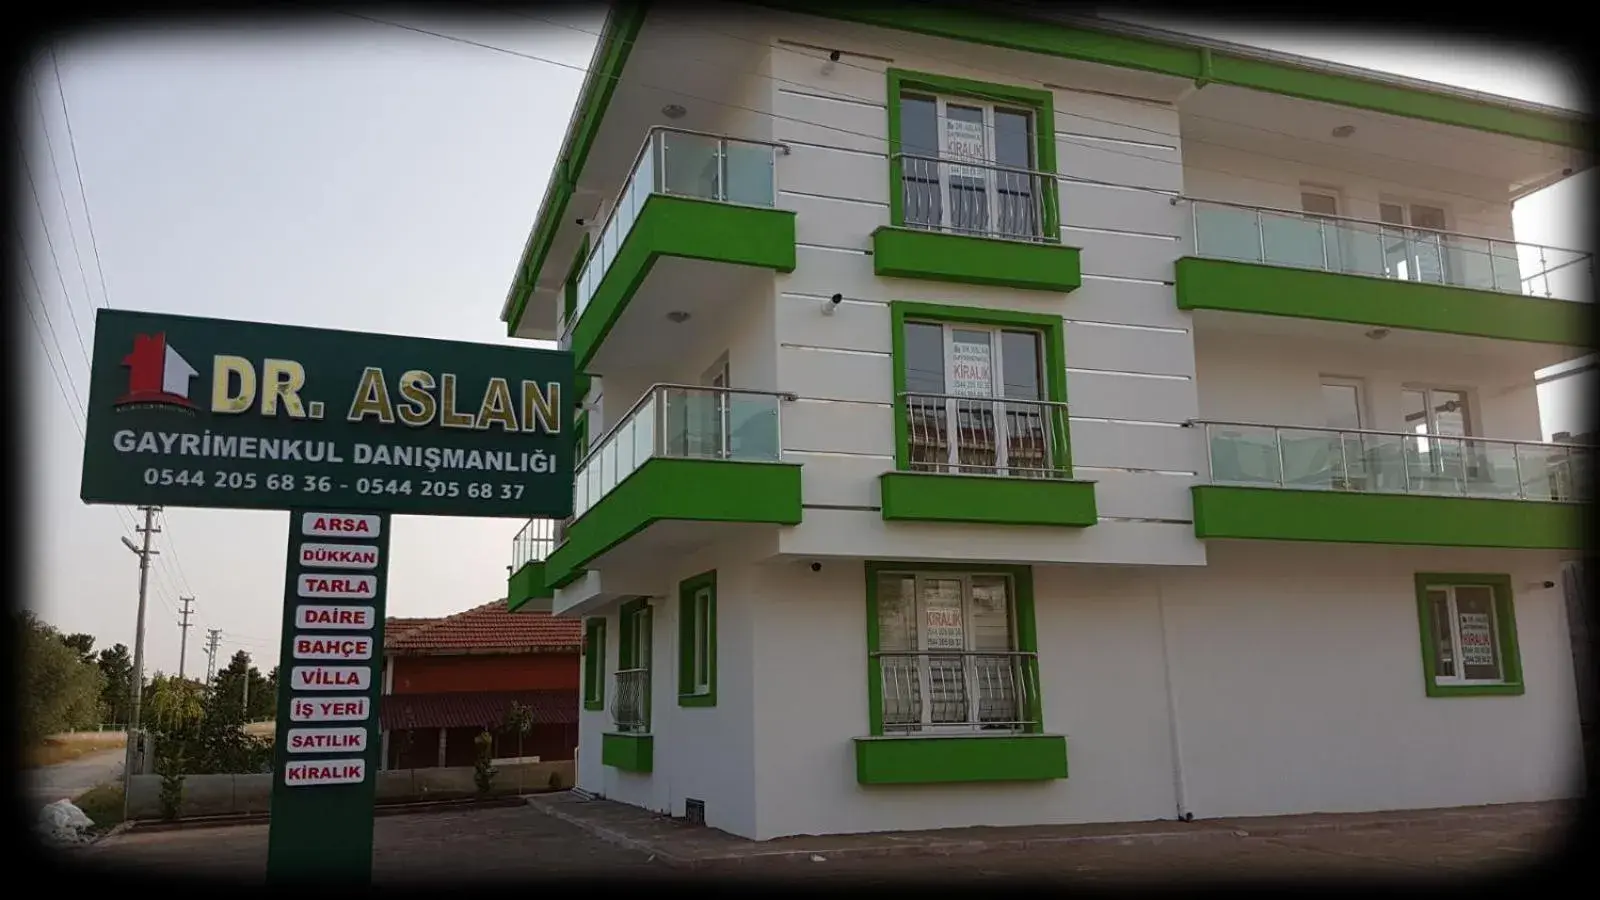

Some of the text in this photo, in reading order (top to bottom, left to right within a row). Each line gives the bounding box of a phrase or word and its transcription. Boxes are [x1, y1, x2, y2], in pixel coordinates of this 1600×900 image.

[211, 354, 561, 434] DR. ASLAN
[113, 428, 556, 474] GAYRİMENKUL DANIŞMANLIĞI
[144, 467, 205, 487] 0544
[214, 471, 257, 489] 205
[267, 473, 294, 491] 68
[303, 475, 331, 492] 36
[356, 477, 412, 496] 0544
[420, 479, 460, 498] 205
[467, 482, 492, 499] 68
[500, 484, 525, 500] 37
[313, 517, 368, 532] ARSA
[303, 548, 375, 563] DÜKKAN
[305, 579, 370, 593] TARLA
[305, 608, 365, 624] DAİRE
[298, 640, 367, 658] BAHÇE
[301, 667, 360, 685] VİLLA
[295, 699, 364, 718] İŞ YERİ
[292, 734, 361, 748] SATILIK
[288, 764, 361, 780] KİRALIK
